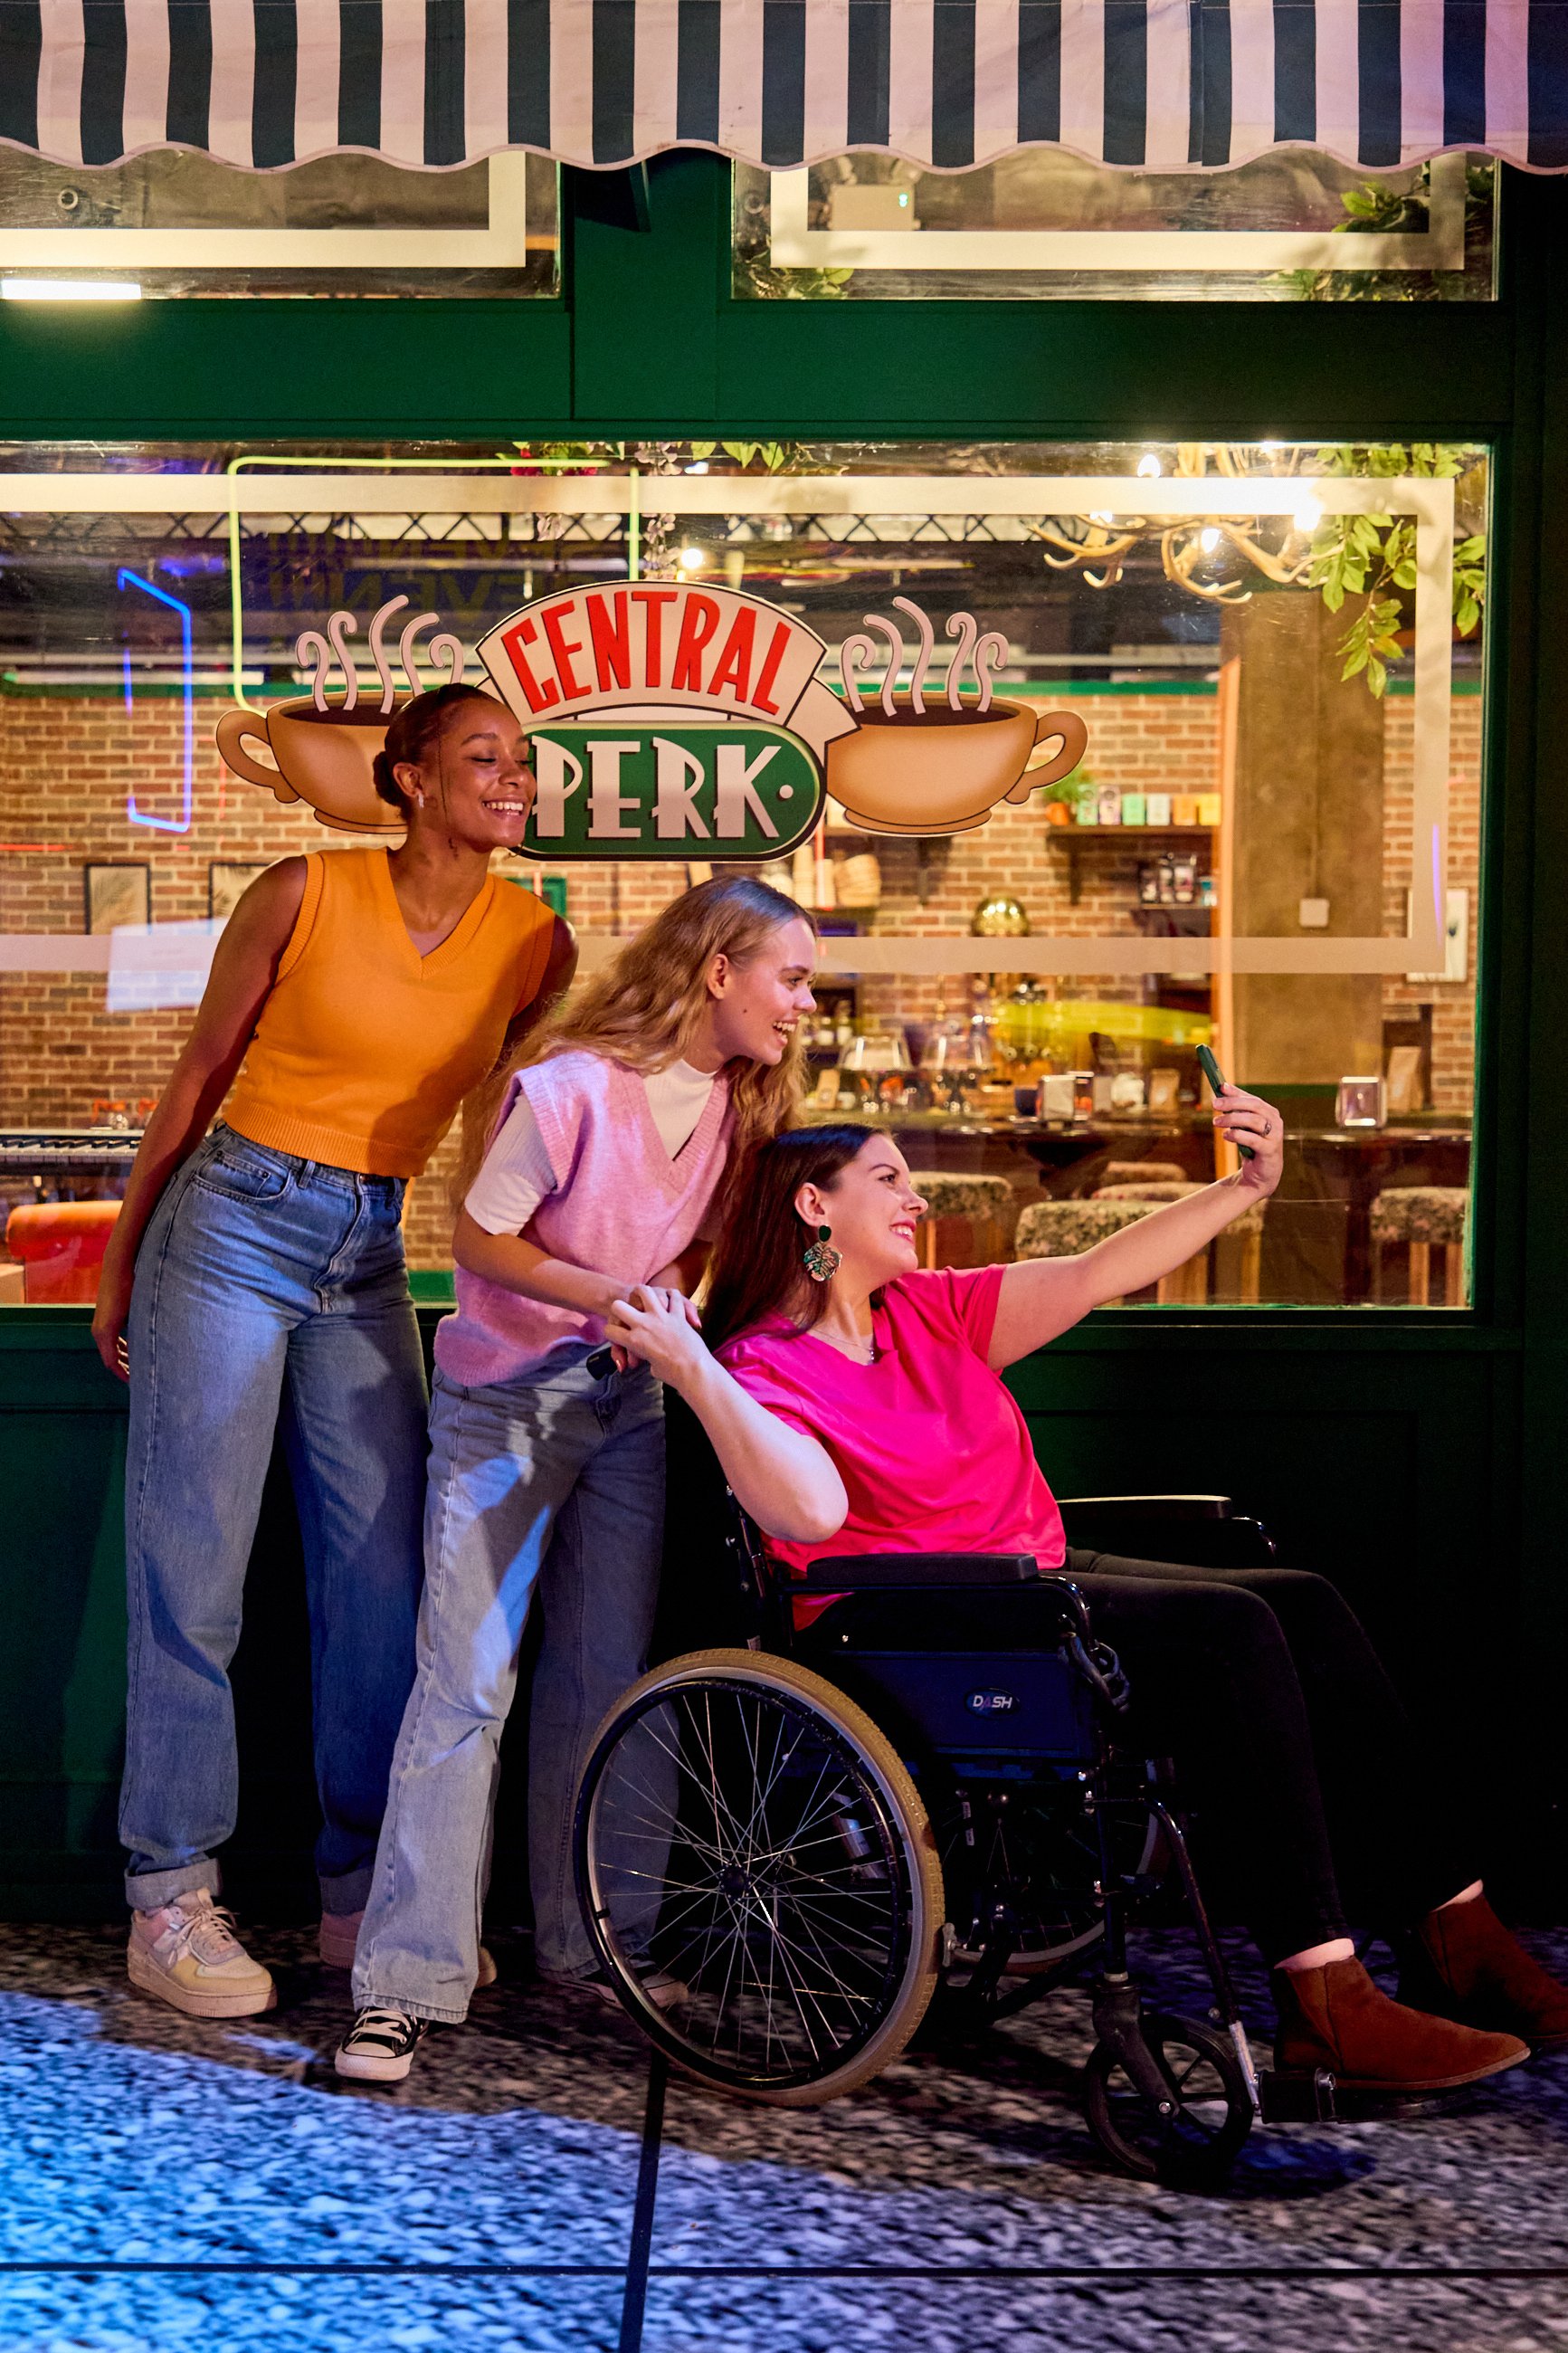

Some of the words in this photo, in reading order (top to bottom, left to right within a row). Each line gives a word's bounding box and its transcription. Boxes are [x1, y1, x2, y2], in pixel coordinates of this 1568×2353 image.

[500, 590, 793, 714] CENTRAL
[531, 735, 782, 839] PERK
[973, 1695, 1012, 1710] DASH
